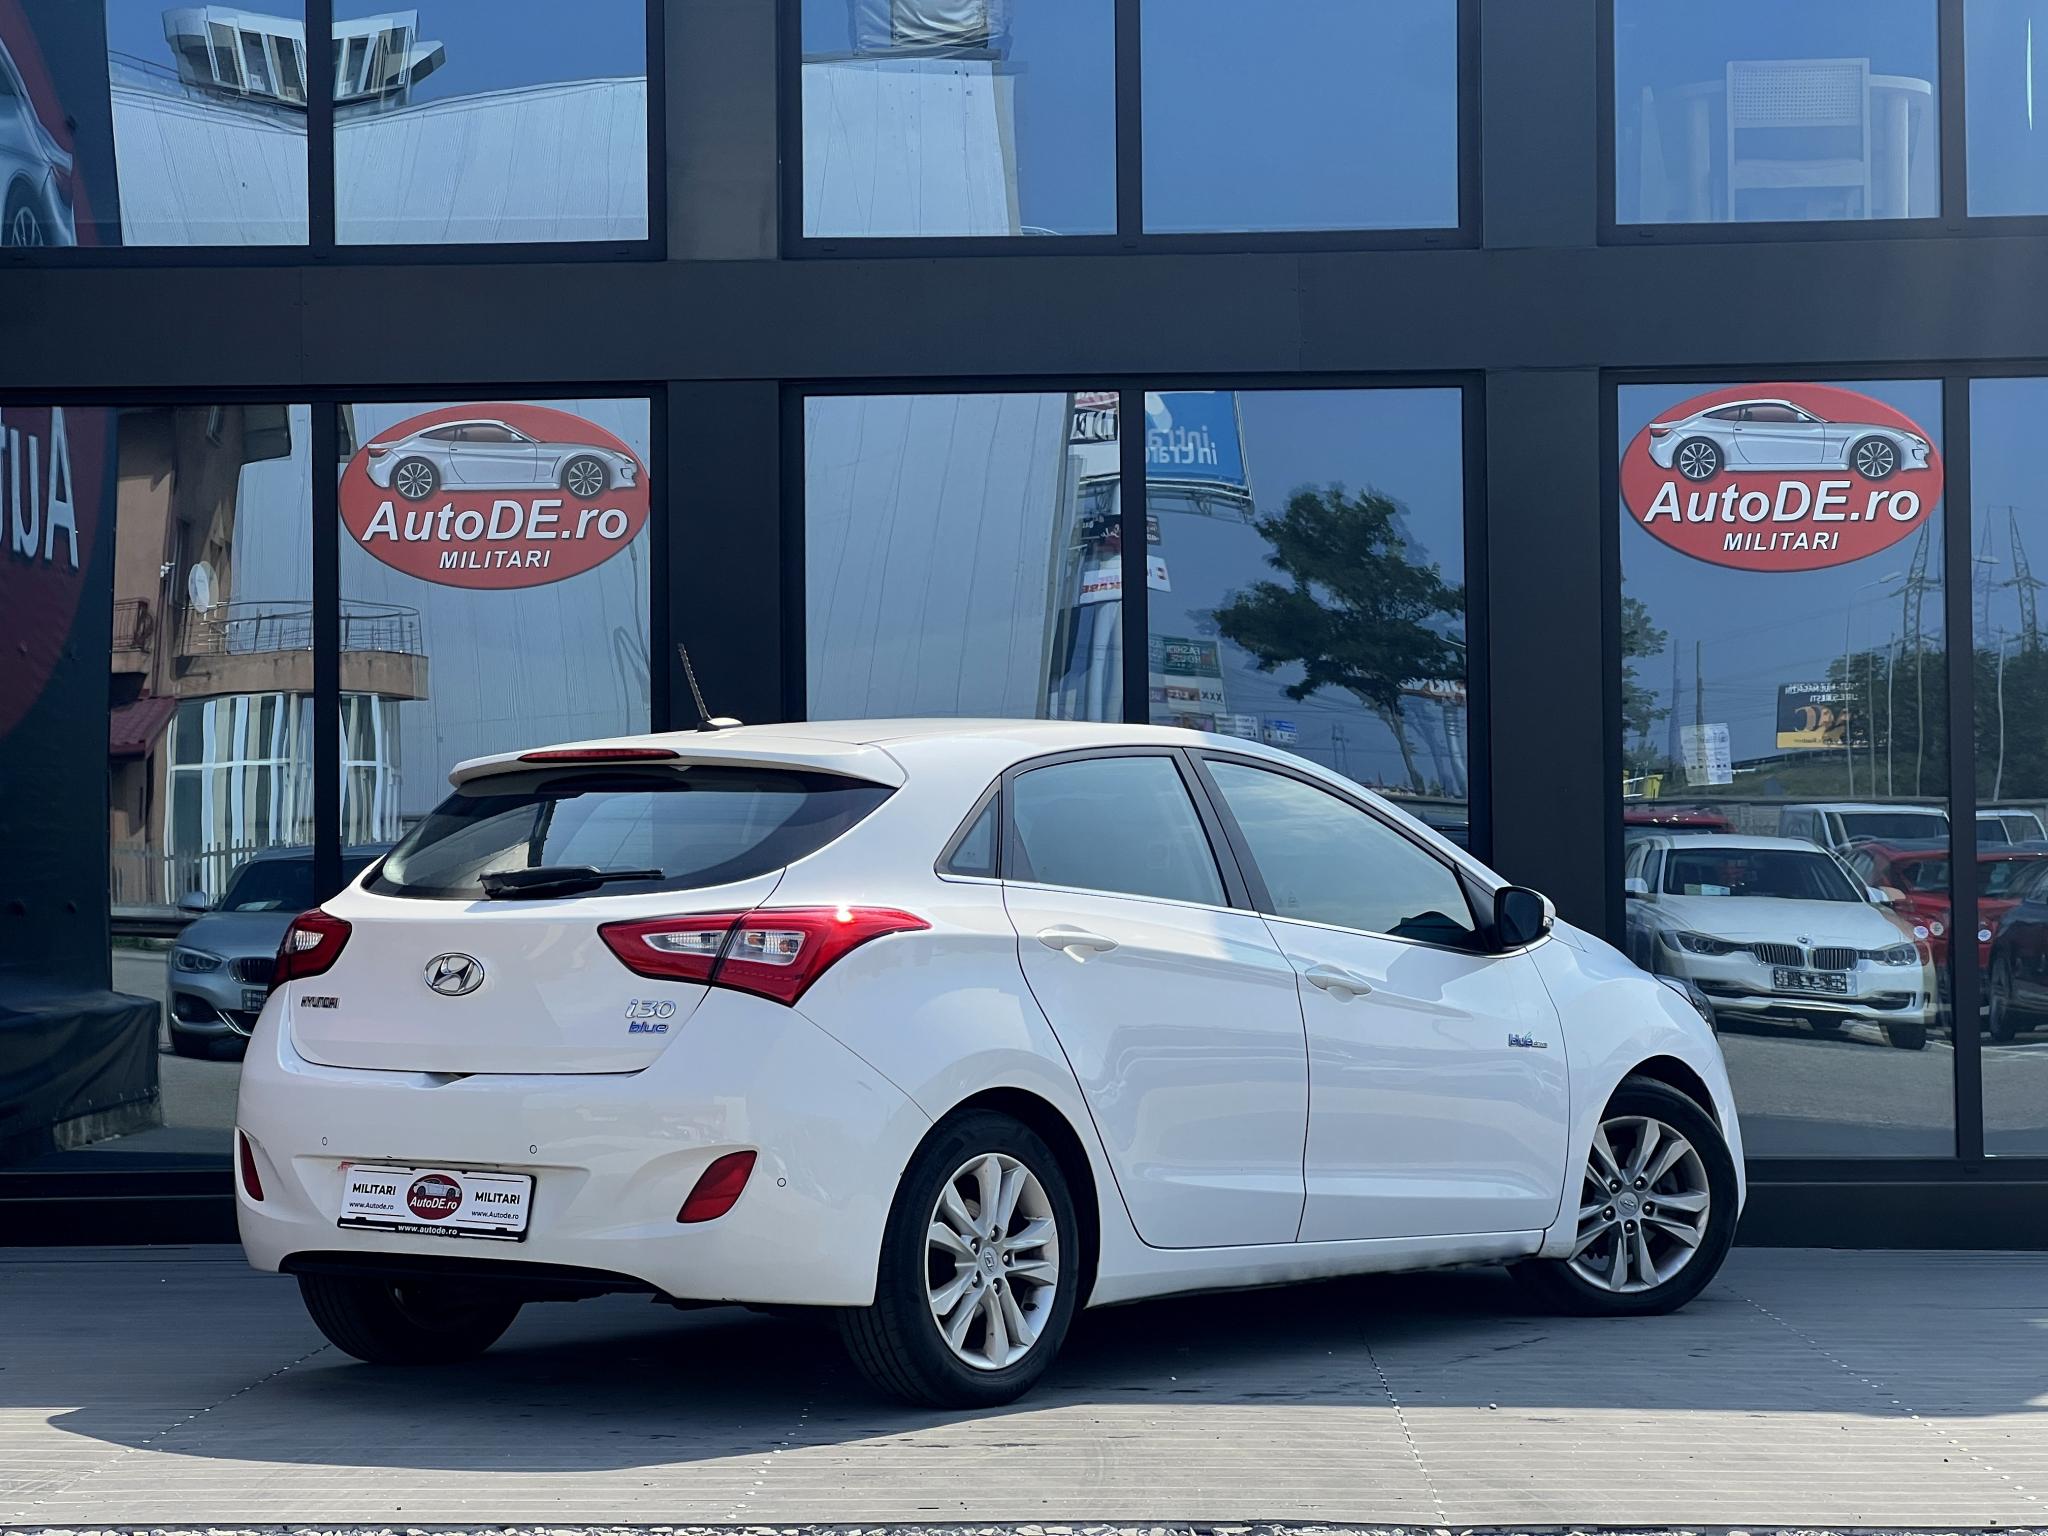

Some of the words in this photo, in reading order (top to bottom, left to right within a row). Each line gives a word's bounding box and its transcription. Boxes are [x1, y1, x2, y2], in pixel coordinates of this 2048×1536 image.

[1642, 480, 1921, 523] AutoDE.ro
[362, 499, 628, 542] AutoDE.ro
[1723, 531, 1839, 551] MILITARI
[439, 549, 551, 570] MILITARI
[300, 996, 340, 1009] HYUNDAI
[624, 999, 676, 1019] i30
[628, 1020, 669, 1034] blue
[352, 1183, 396, 1196] MILITARI
[409, 1196, 458, 1211] AutoDE.ro
[474, 1191, 520, 1205] MILITARI
[348, 1201, 394, 1210] www.Autode.ro
[471, 1209, 519, 1220] www.Autode.ro
[397, 1223, 458, 1236] www.autode.ro
